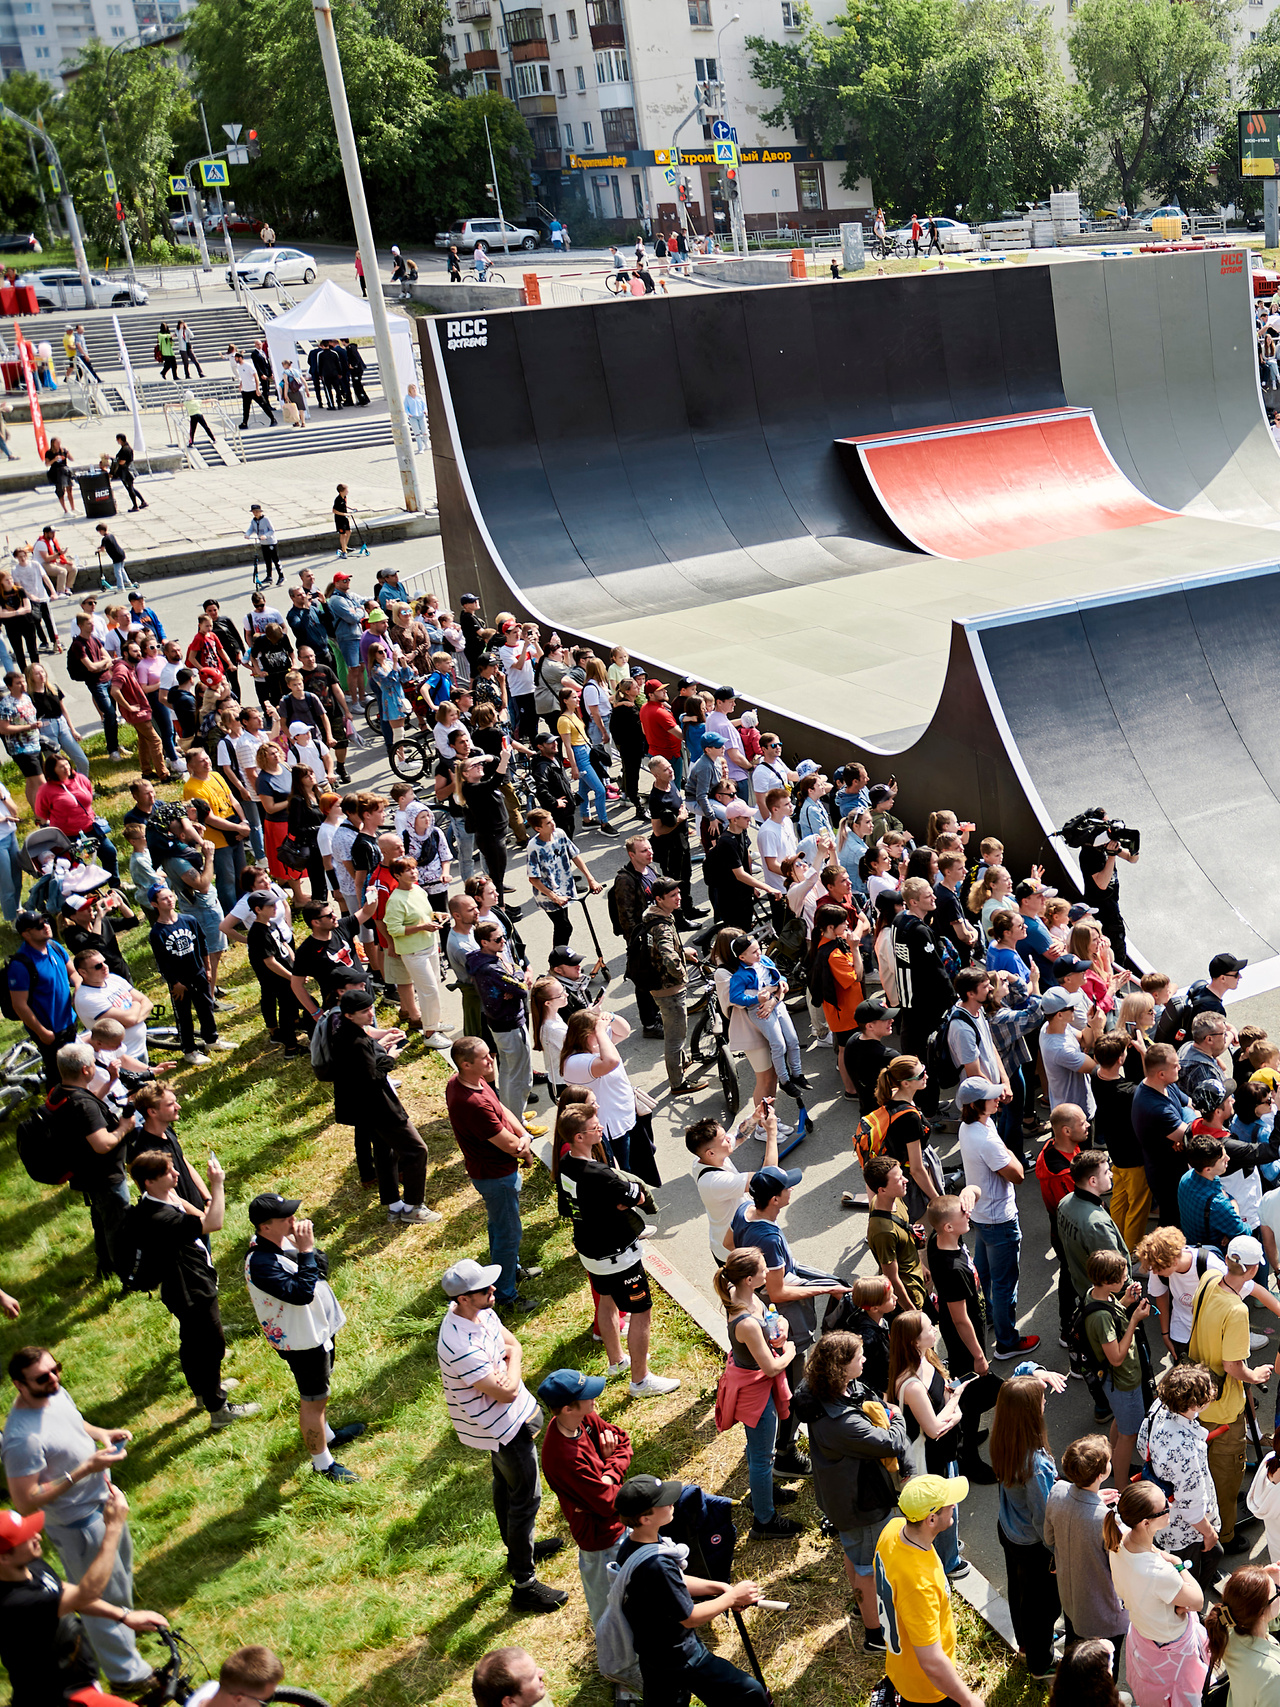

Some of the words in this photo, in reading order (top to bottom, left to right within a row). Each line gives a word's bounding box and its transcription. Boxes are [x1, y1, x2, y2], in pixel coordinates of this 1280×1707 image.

[680, 151, 759, 166] троитый
[761, 150, 792, 163] Двор
[1220, 252, 1243, 266] RCC
[446, 319, 488, 338] RCC
[447, 336, 488, 351] EXTREME
